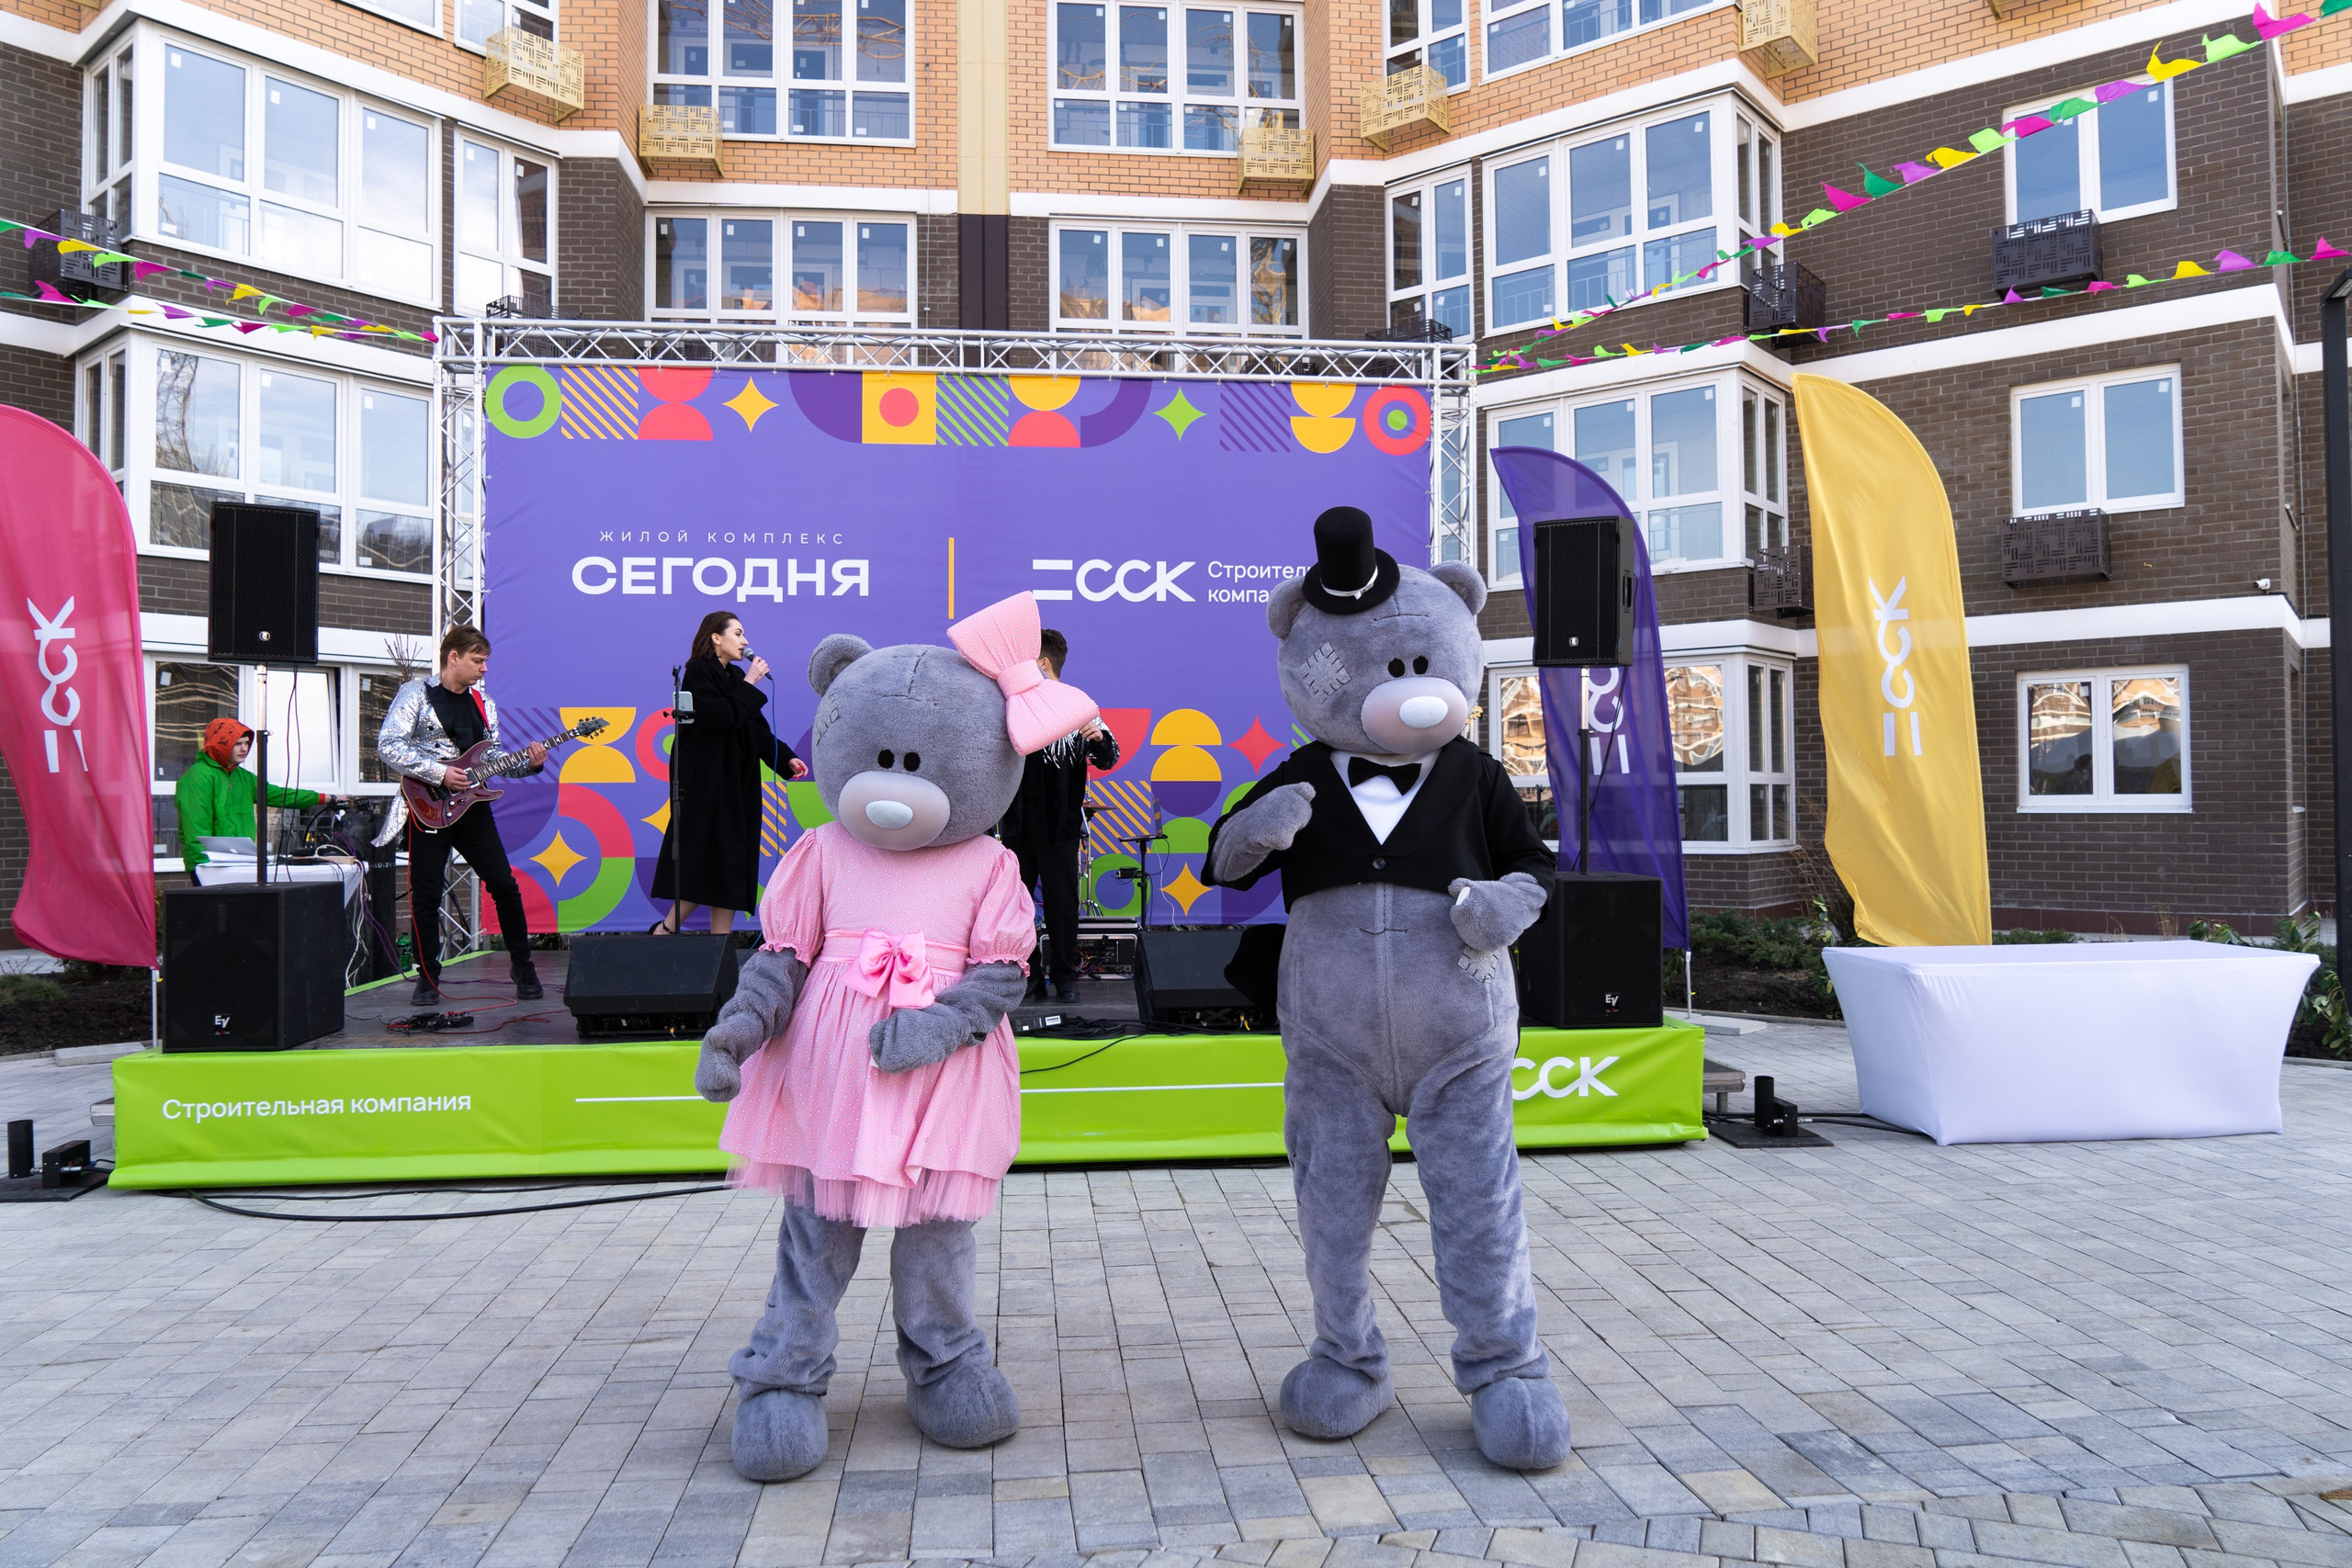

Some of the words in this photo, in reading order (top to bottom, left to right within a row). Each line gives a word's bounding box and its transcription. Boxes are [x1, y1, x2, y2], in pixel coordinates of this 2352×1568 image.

[599, 529, 688, 543] ЖИЛОЙ
[707, 532, 842, 545] КОМПЛЕКС
[571, 556, 870, 604] СЕГОДНЯ
[1207, 560, 1312, 583] Строител
[1207, 589, 1273, 603] компа
[161, 1099, 344, 1124] Строительная
[350, 1095, 471, 1114] компания
